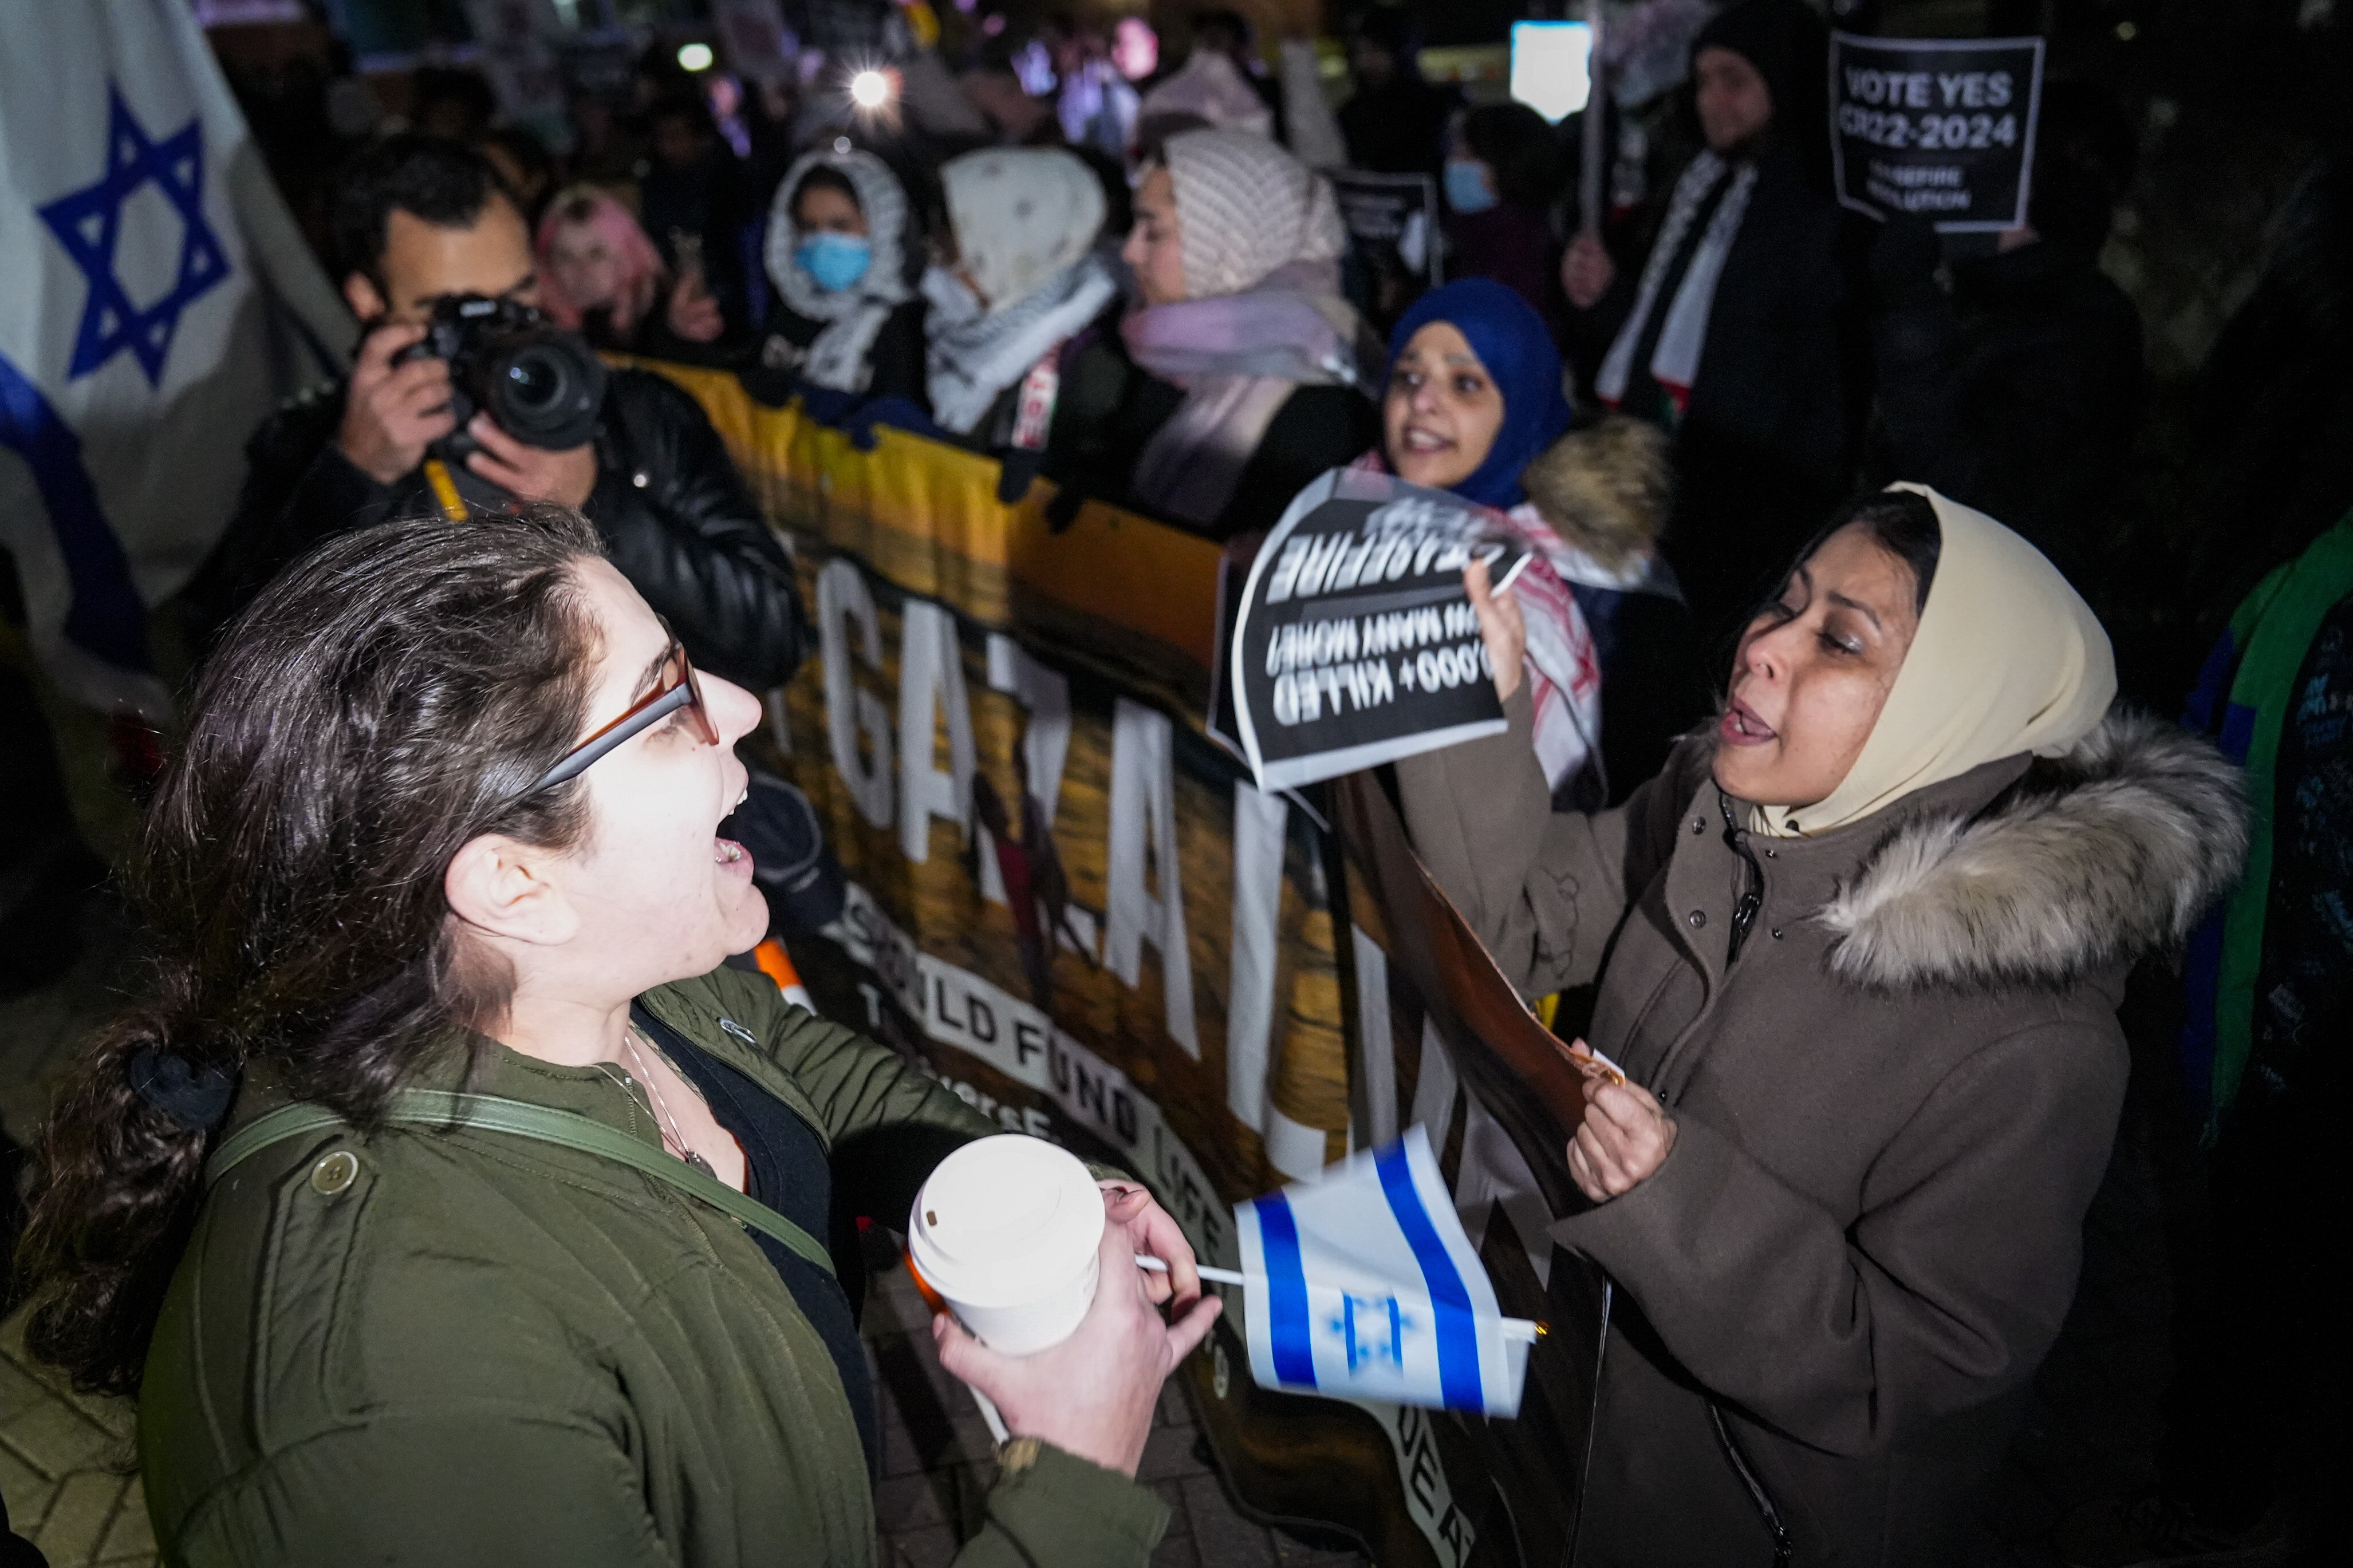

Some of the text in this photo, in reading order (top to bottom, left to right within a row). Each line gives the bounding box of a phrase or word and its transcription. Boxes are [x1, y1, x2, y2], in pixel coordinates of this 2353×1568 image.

[1845, 66, 2013, 107] VOTE YES
[1839, 102, 2017, 148] CR22-2024
[1265, 601, 1480, 677] OW MANY MORE?
[1272, 659, 1395, 726] KILLED
[816, 557, 1201, 1063] GAZA
[1014, 1021, 1137, 1147] FUND
[1152, 1124, 1222, 1266] LIFE
